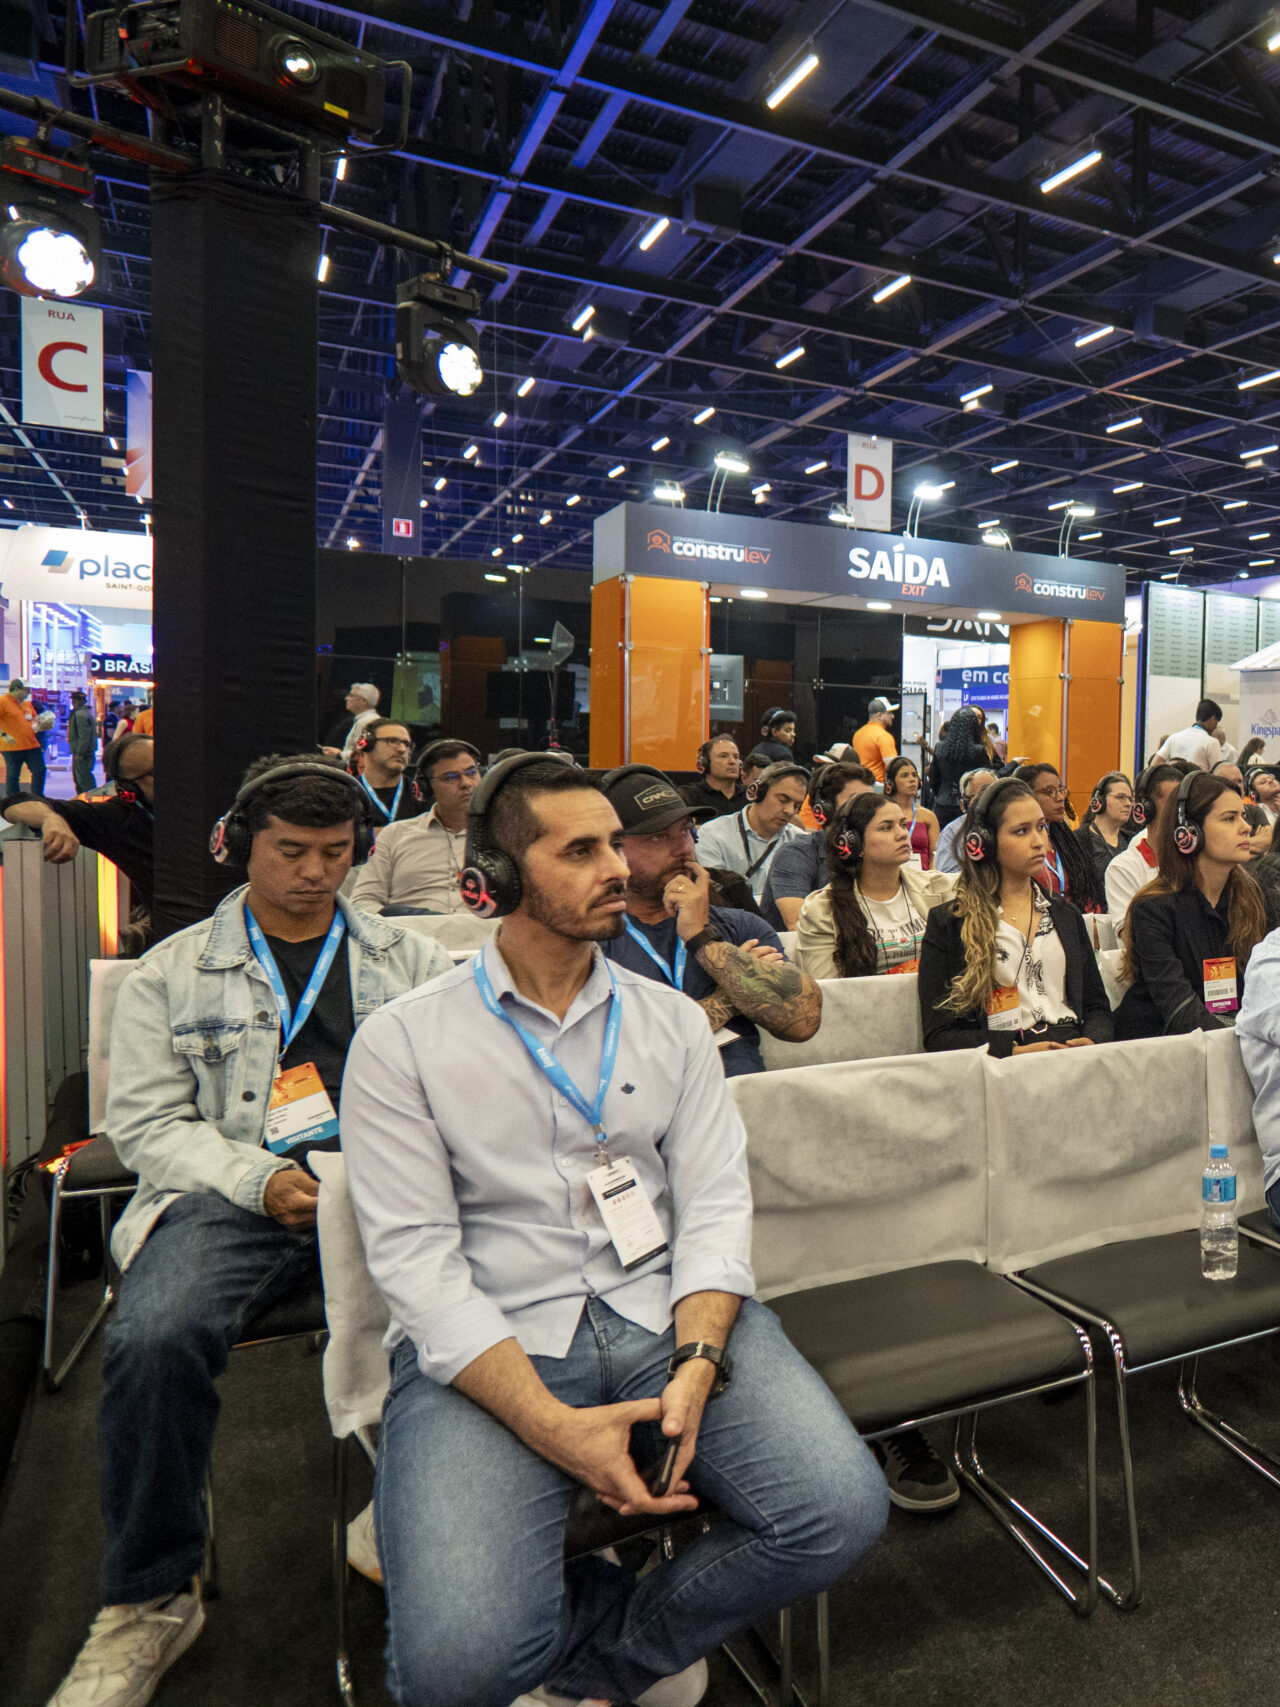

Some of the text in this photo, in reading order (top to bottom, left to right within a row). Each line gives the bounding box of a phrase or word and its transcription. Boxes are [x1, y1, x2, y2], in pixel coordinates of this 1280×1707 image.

[47, 309, 76, 322] RUA
[38, 341, 88, 393] C
[861, 442, 877, 450] RUA
[854, 463, 885, 501] D
[672, 541, 771, 565] construlev
[79, 554, 151, 580] plac
[848, 543, 950, 588] SAÍDA
[105, 582, 152, 592] SAINT-GO
[901, 584, 928, 597] EXIT
[1033, 583, 1106, 601] construlev
[961, 669, 988, 683] em
[284, 1125, 325, 1145] VISITANTE
